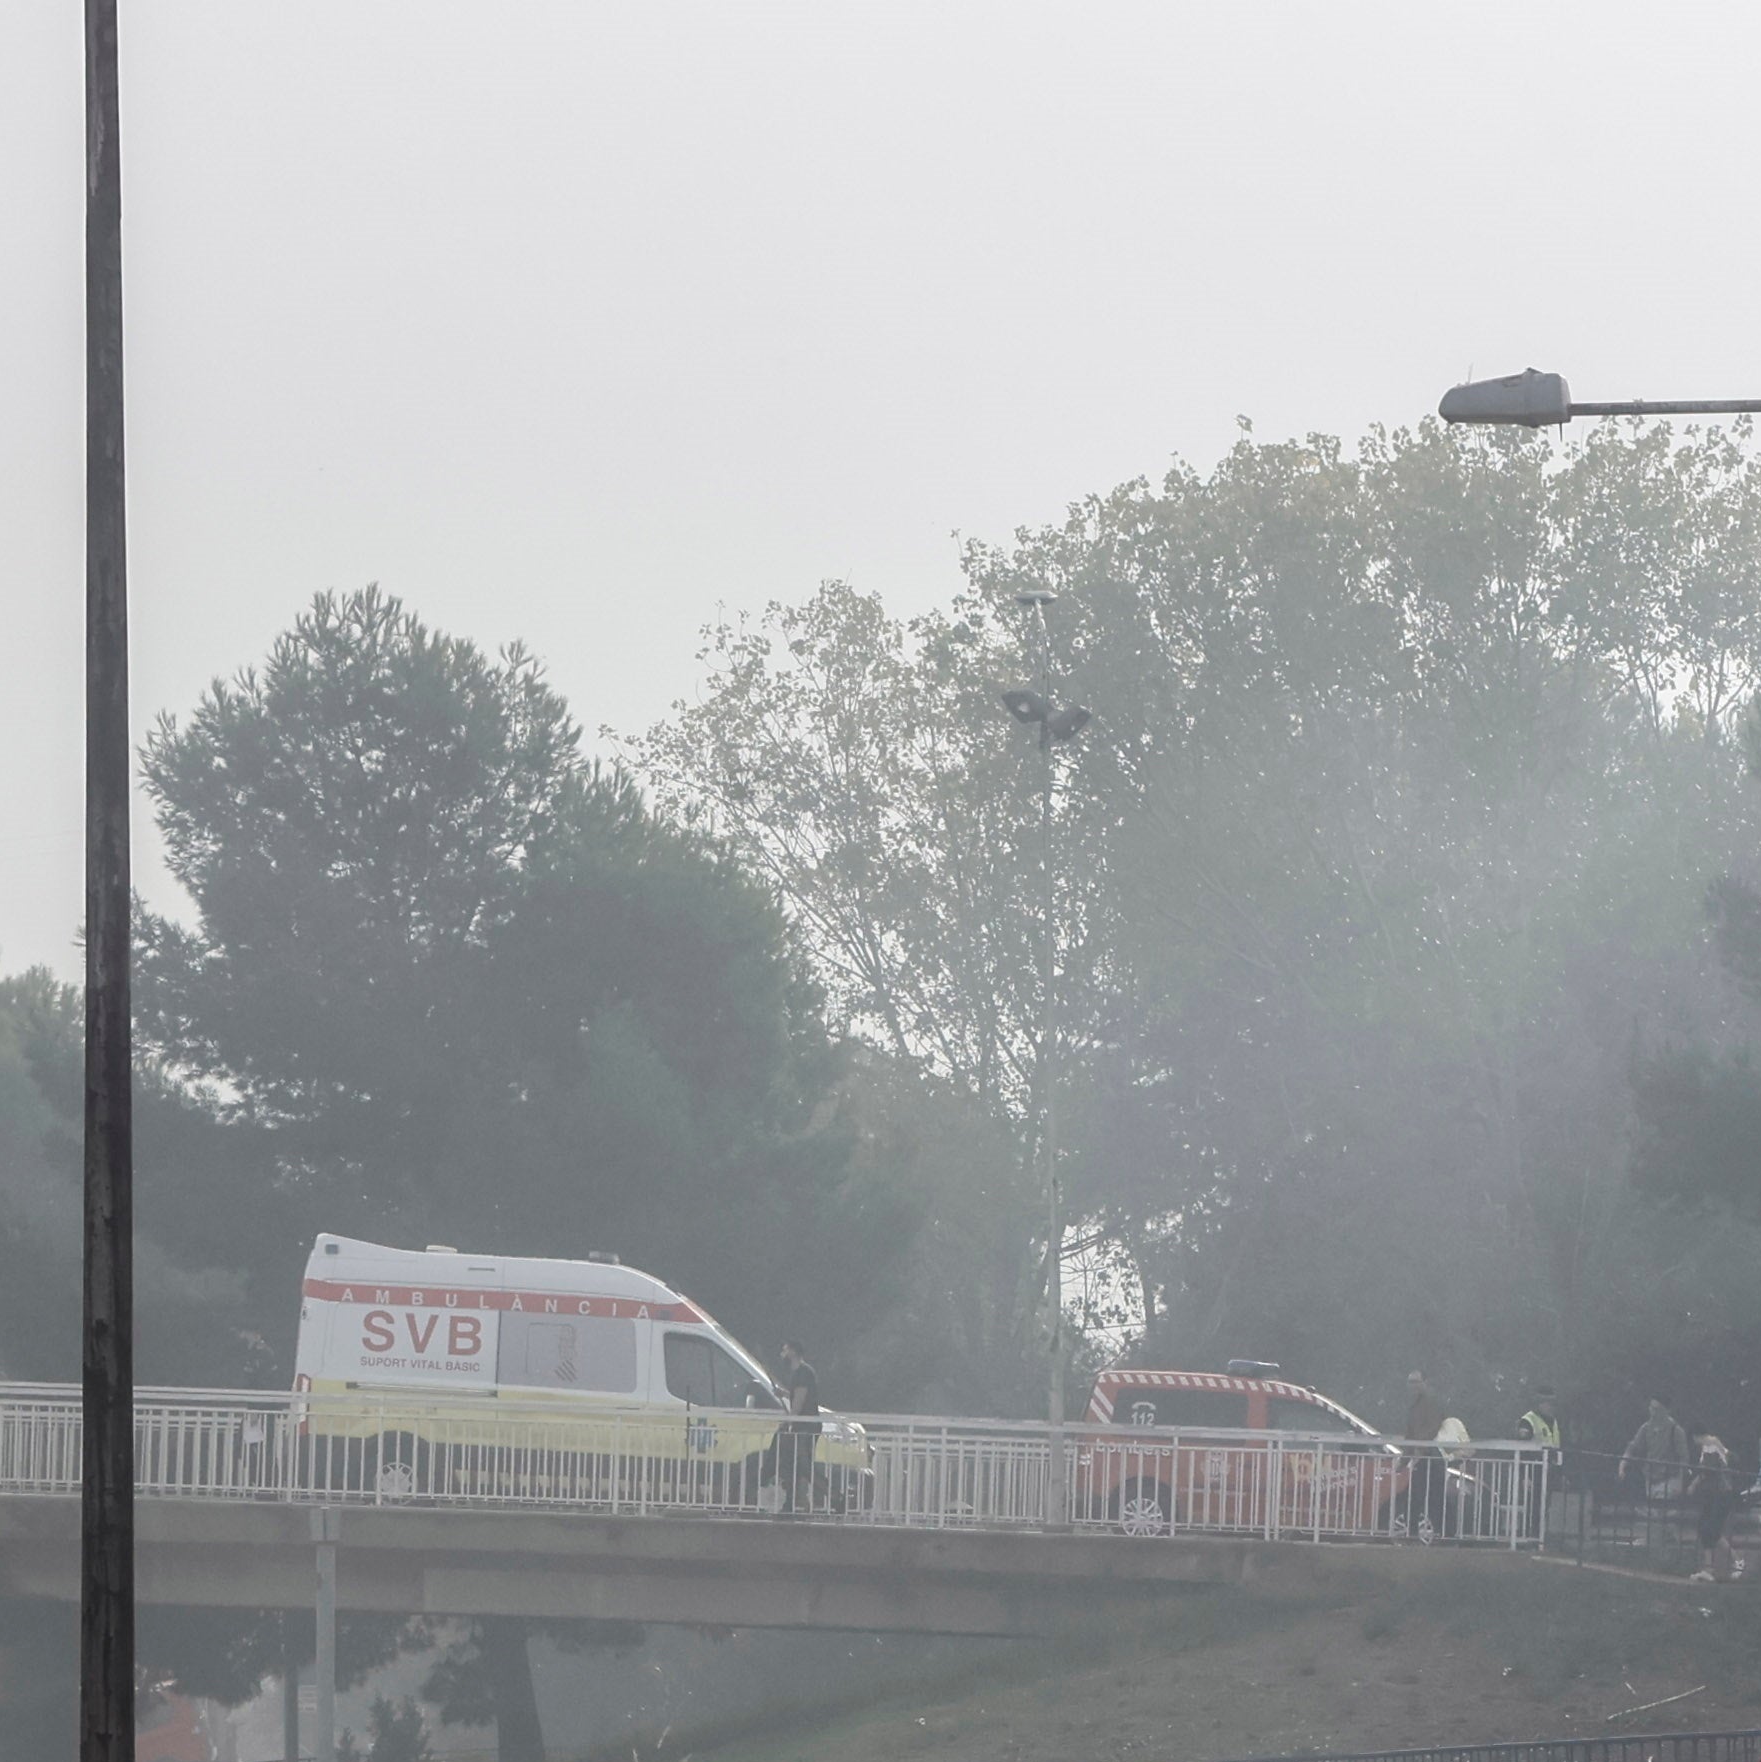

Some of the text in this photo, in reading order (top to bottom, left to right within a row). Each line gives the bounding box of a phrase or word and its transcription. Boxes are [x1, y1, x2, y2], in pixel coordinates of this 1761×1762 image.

[341, 1287, 650, 1319] AMBULÀNCIA
[362, 1310, 482, 1356] SVB
[360, 1355, 407, 1368] SUPORT
[410, 1358, 443, 1371] VITAL
[1131, 1411, 1155, 1427] 112
